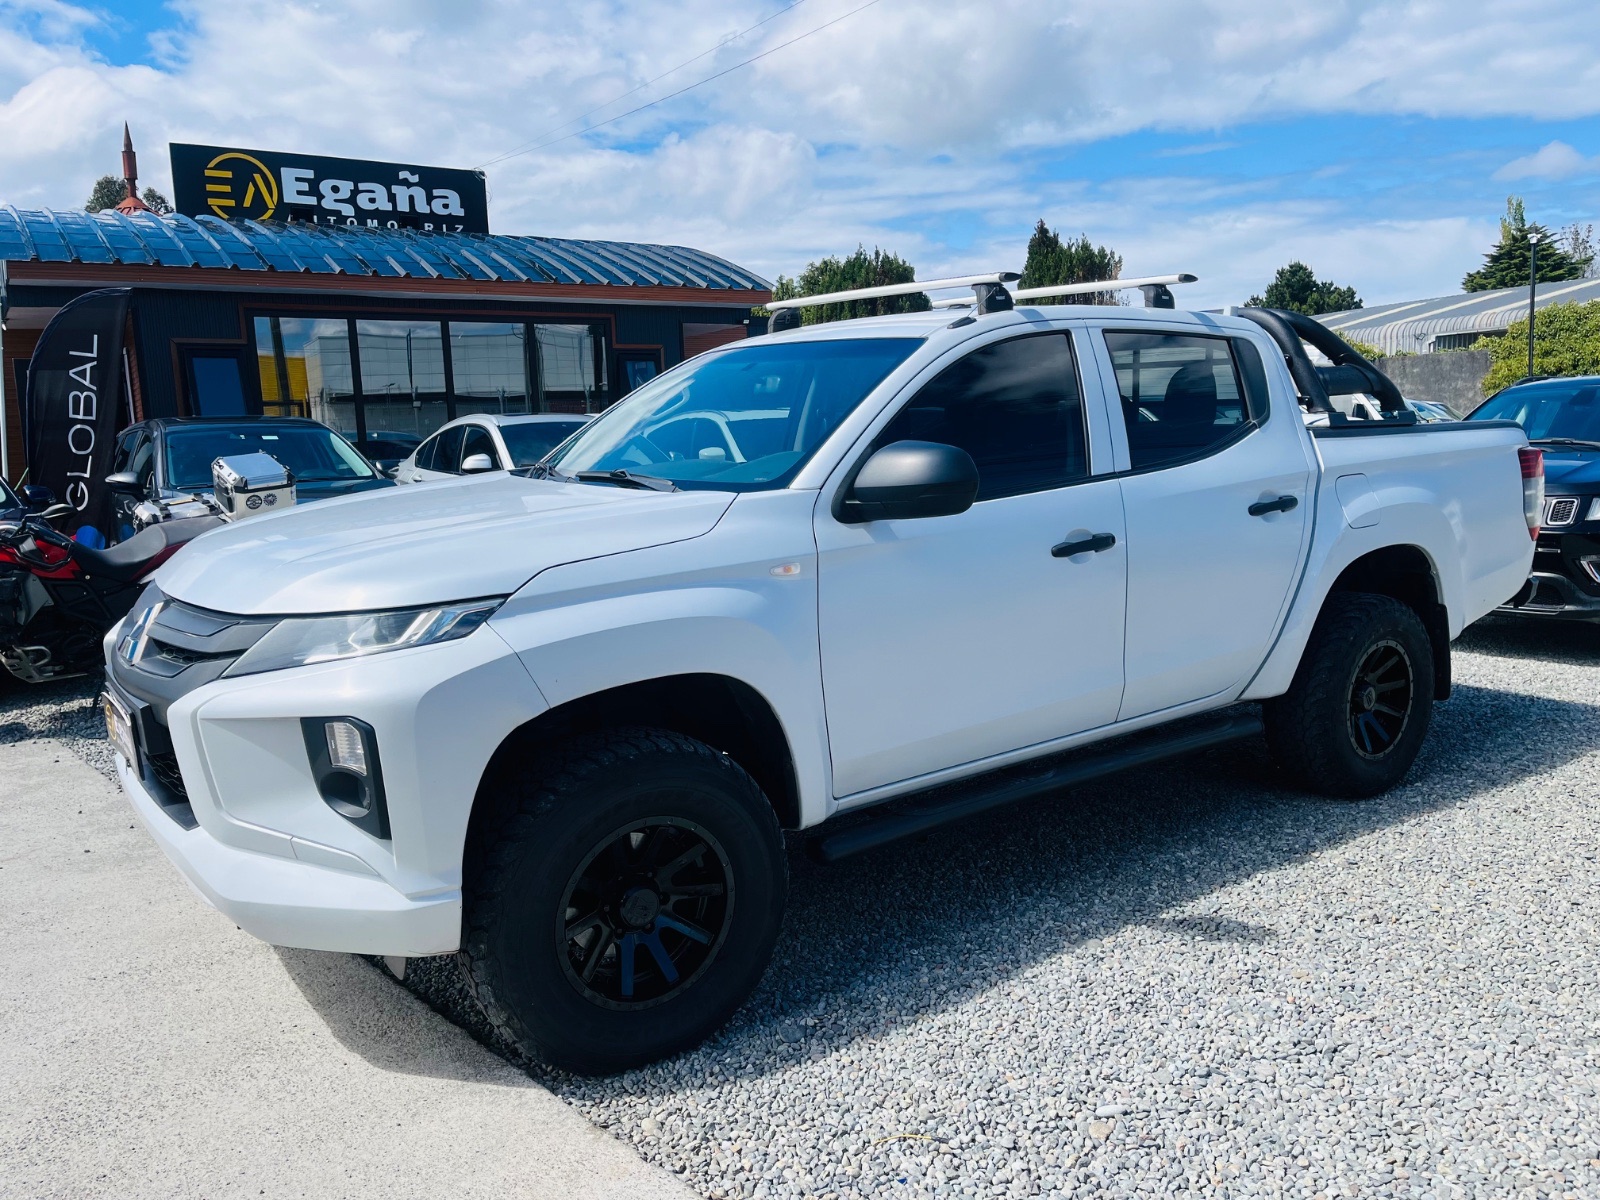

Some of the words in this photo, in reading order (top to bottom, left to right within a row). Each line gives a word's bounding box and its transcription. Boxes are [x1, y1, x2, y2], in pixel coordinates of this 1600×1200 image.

[280, 167, 464, 217] Egaña
[287, 213, 464, 233] TOMORIZ
[65, 334, 98, 511] GLOBAL
